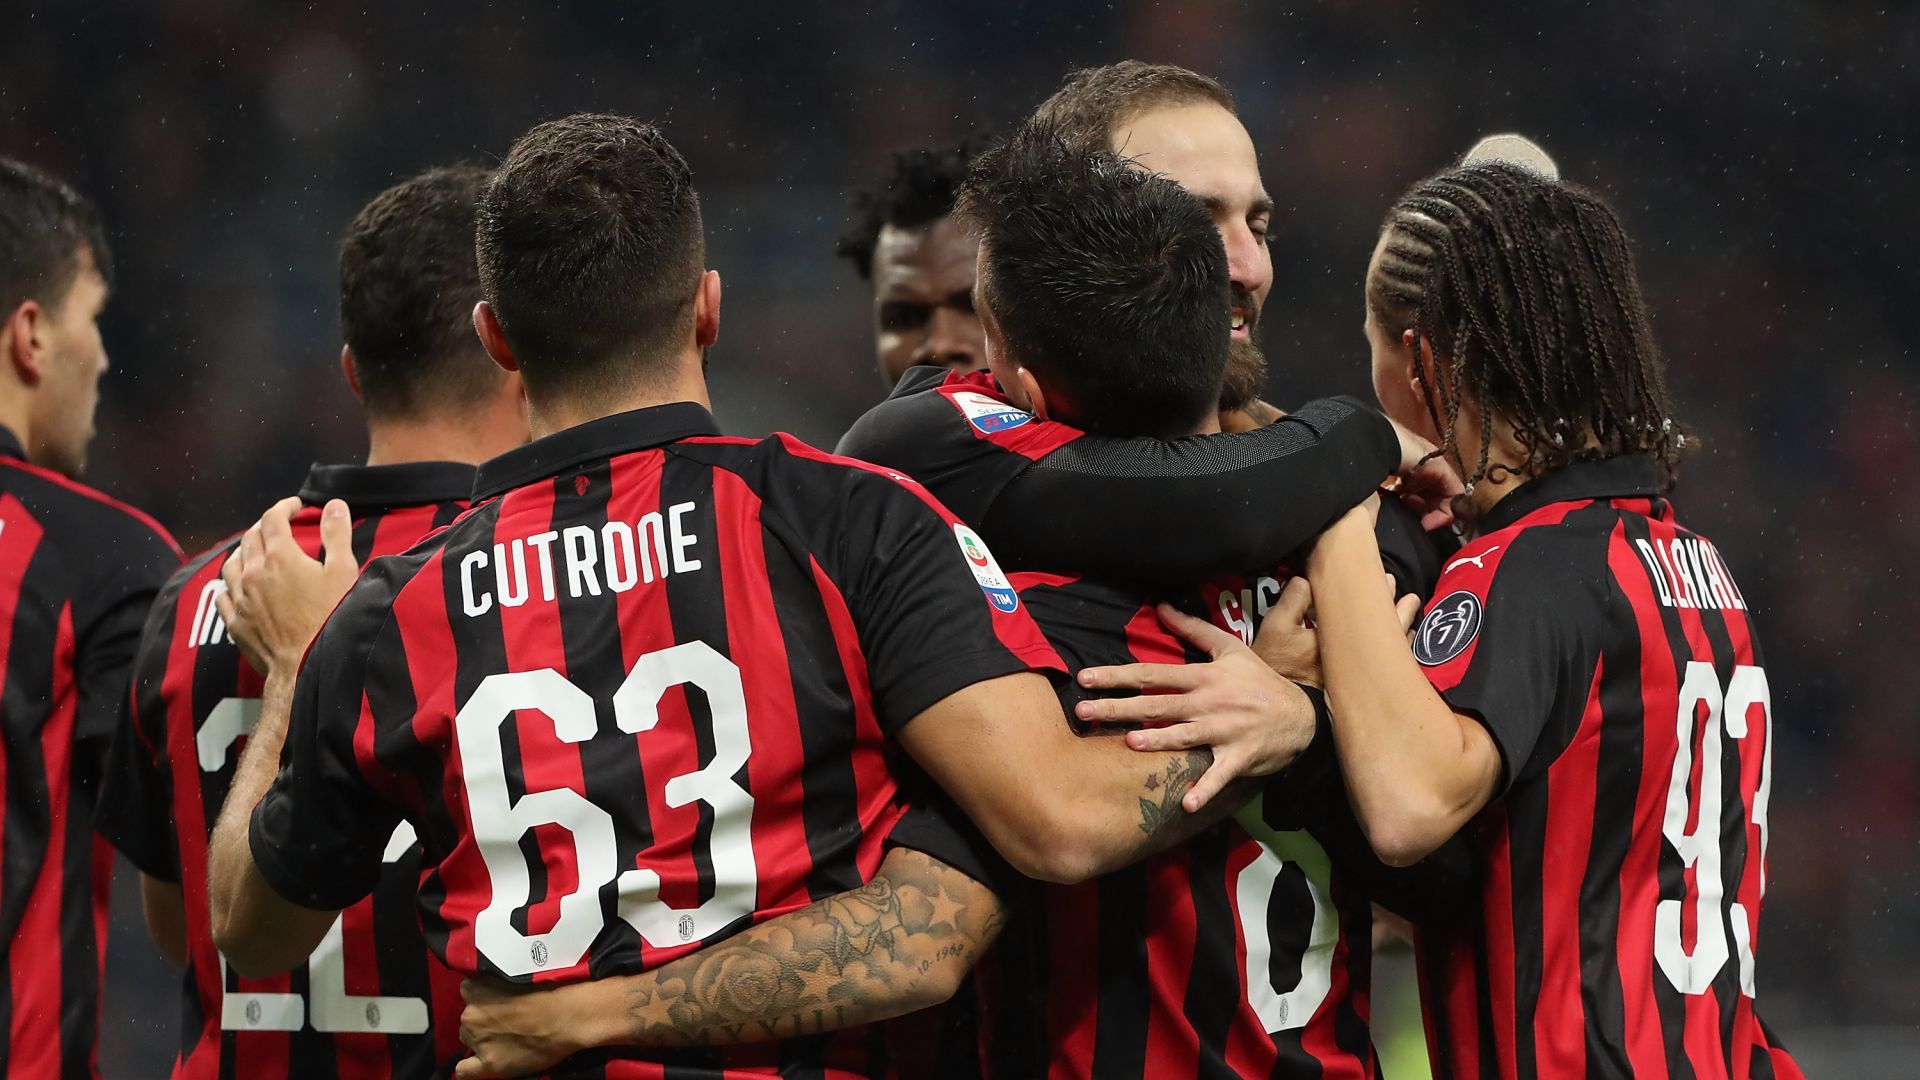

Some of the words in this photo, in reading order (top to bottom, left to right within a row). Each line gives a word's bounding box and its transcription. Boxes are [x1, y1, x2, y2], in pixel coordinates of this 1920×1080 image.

[999, 413, 1028, 424] TIM
[460, 501, 702, 617] CUTRONE
[1636, 538, 1748, 611] D.LAXAL
[992, 593, 1013, 605] TIM
[1438, 624, 1454, 644] 7
[455, 640, 757, 977] 63
[1654, 661, 1772, 999] 93
